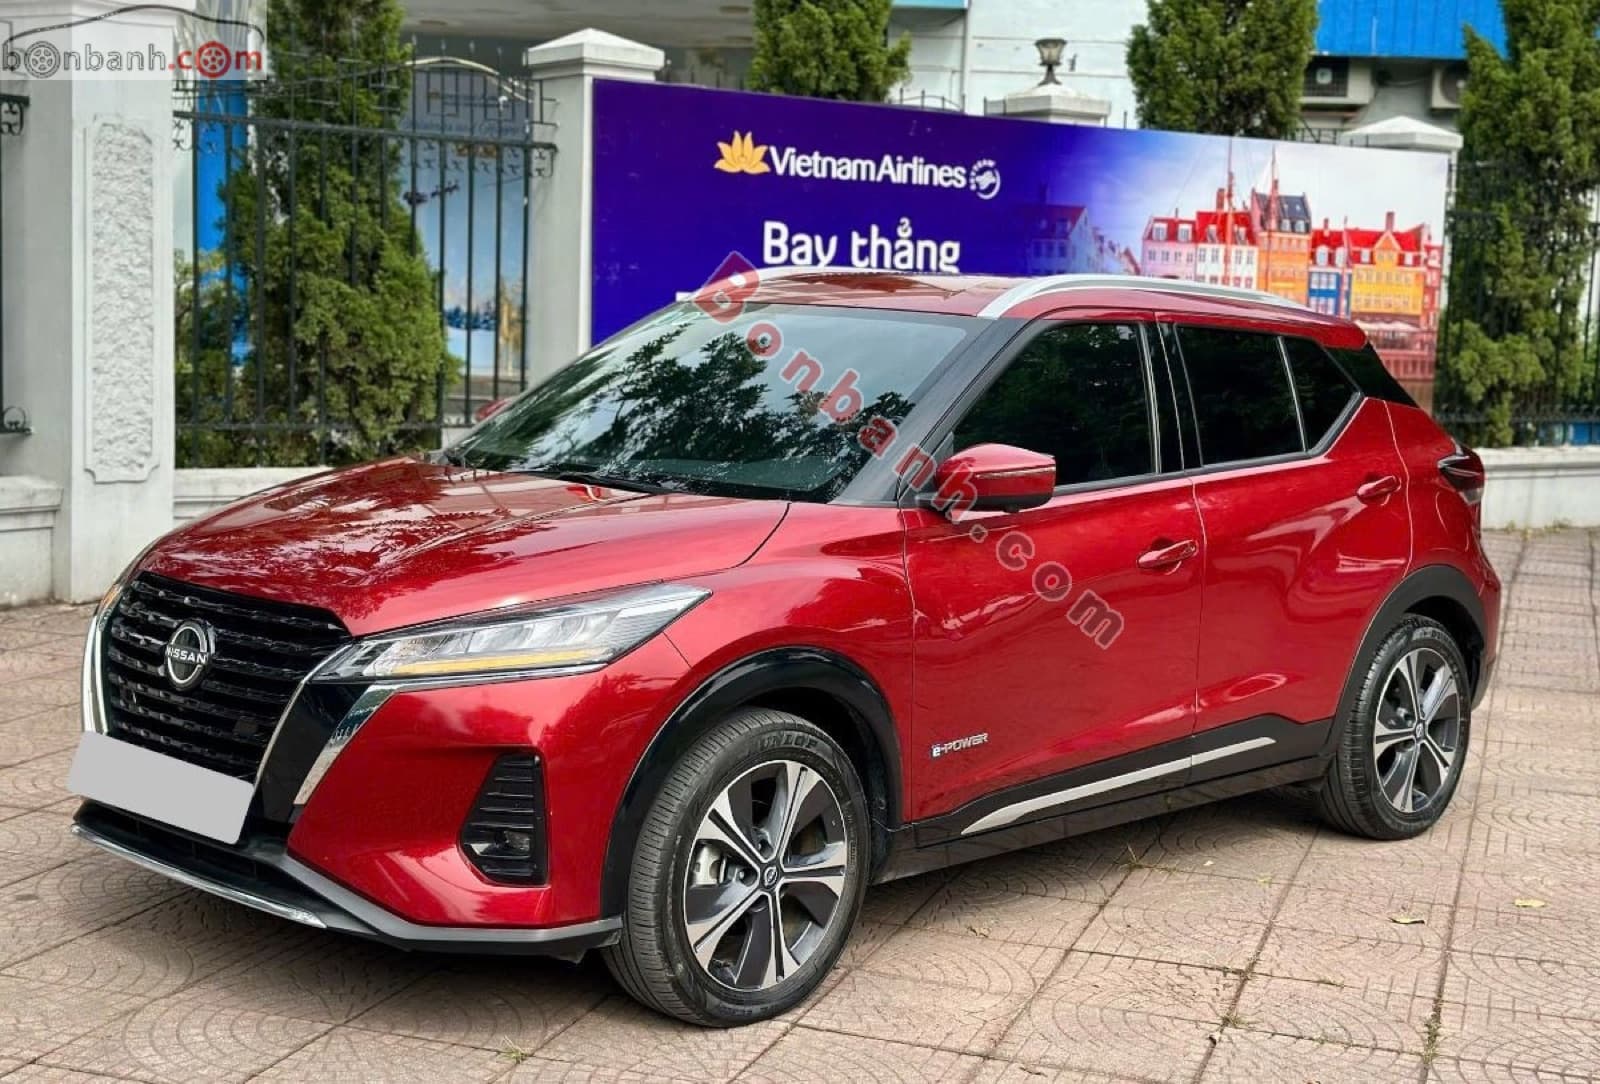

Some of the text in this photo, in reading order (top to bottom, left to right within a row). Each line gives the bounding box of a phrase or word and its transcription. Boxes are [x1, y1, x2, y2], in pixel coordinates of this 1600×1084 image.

[763, 216, 961, 273] Bay thẳng
[166, 645, 209, 664] NISSAN
